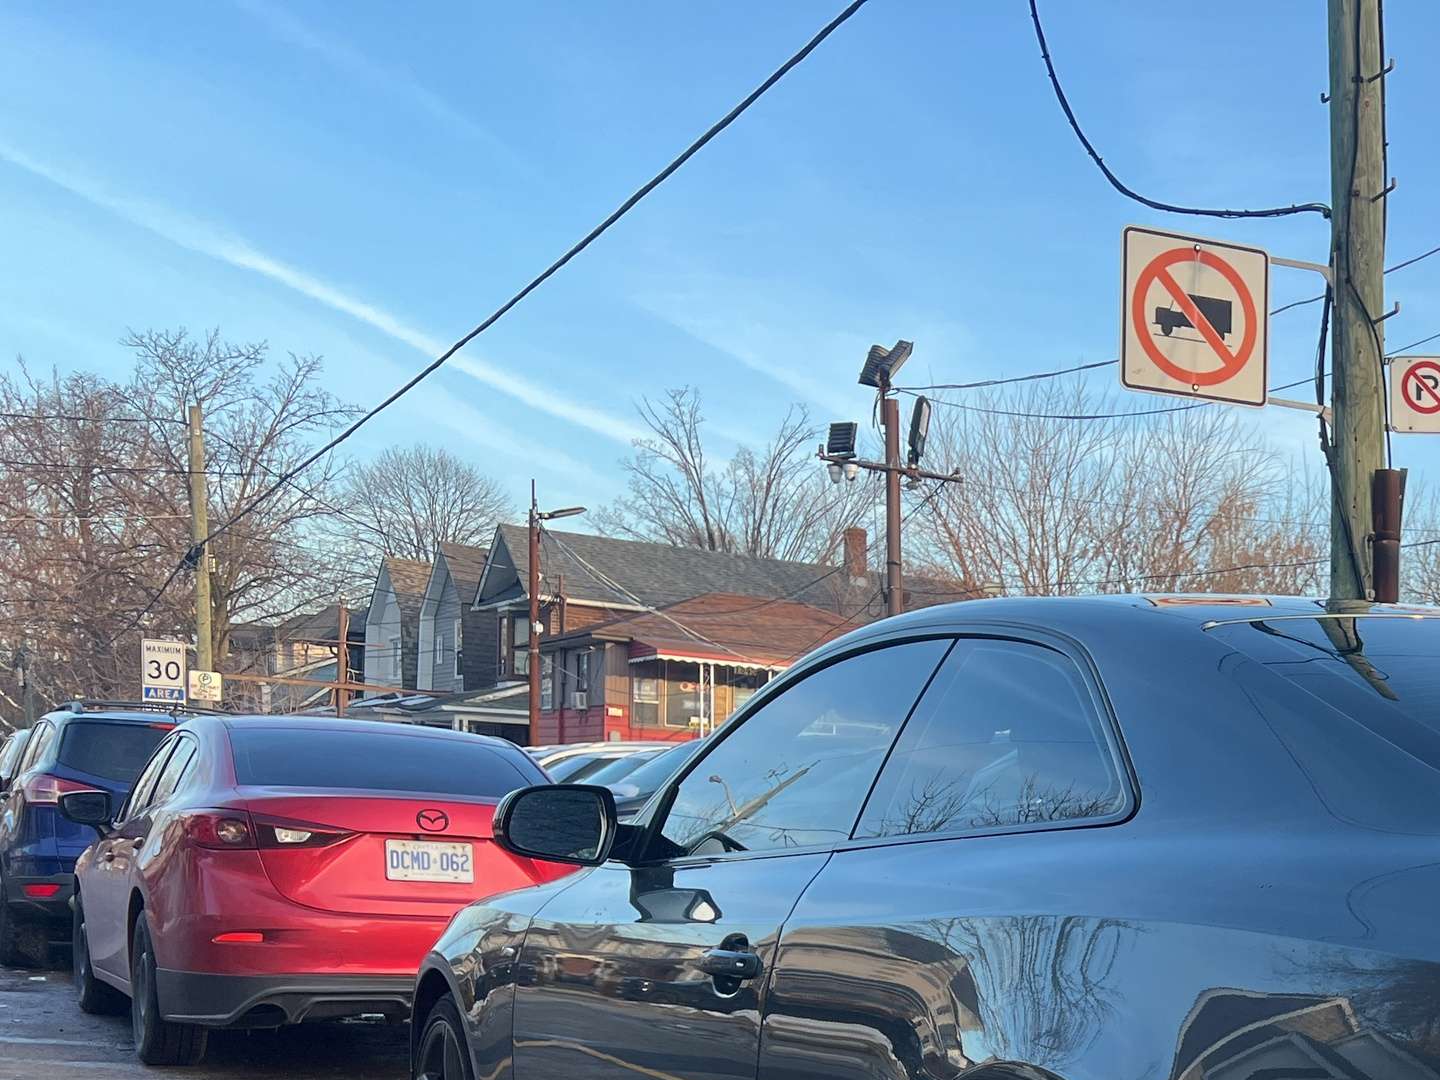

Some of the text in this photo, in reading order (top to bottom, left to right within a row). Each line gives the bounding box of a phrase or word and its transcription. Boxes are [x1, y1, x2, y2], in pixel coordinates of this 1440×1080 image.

[146, 646, 181, 654] MAXIMUM
[148, 660, 180, 680] 30
[148, 688, 180, 699] AREA
[390, 850, 469, 872] DCMD 062
